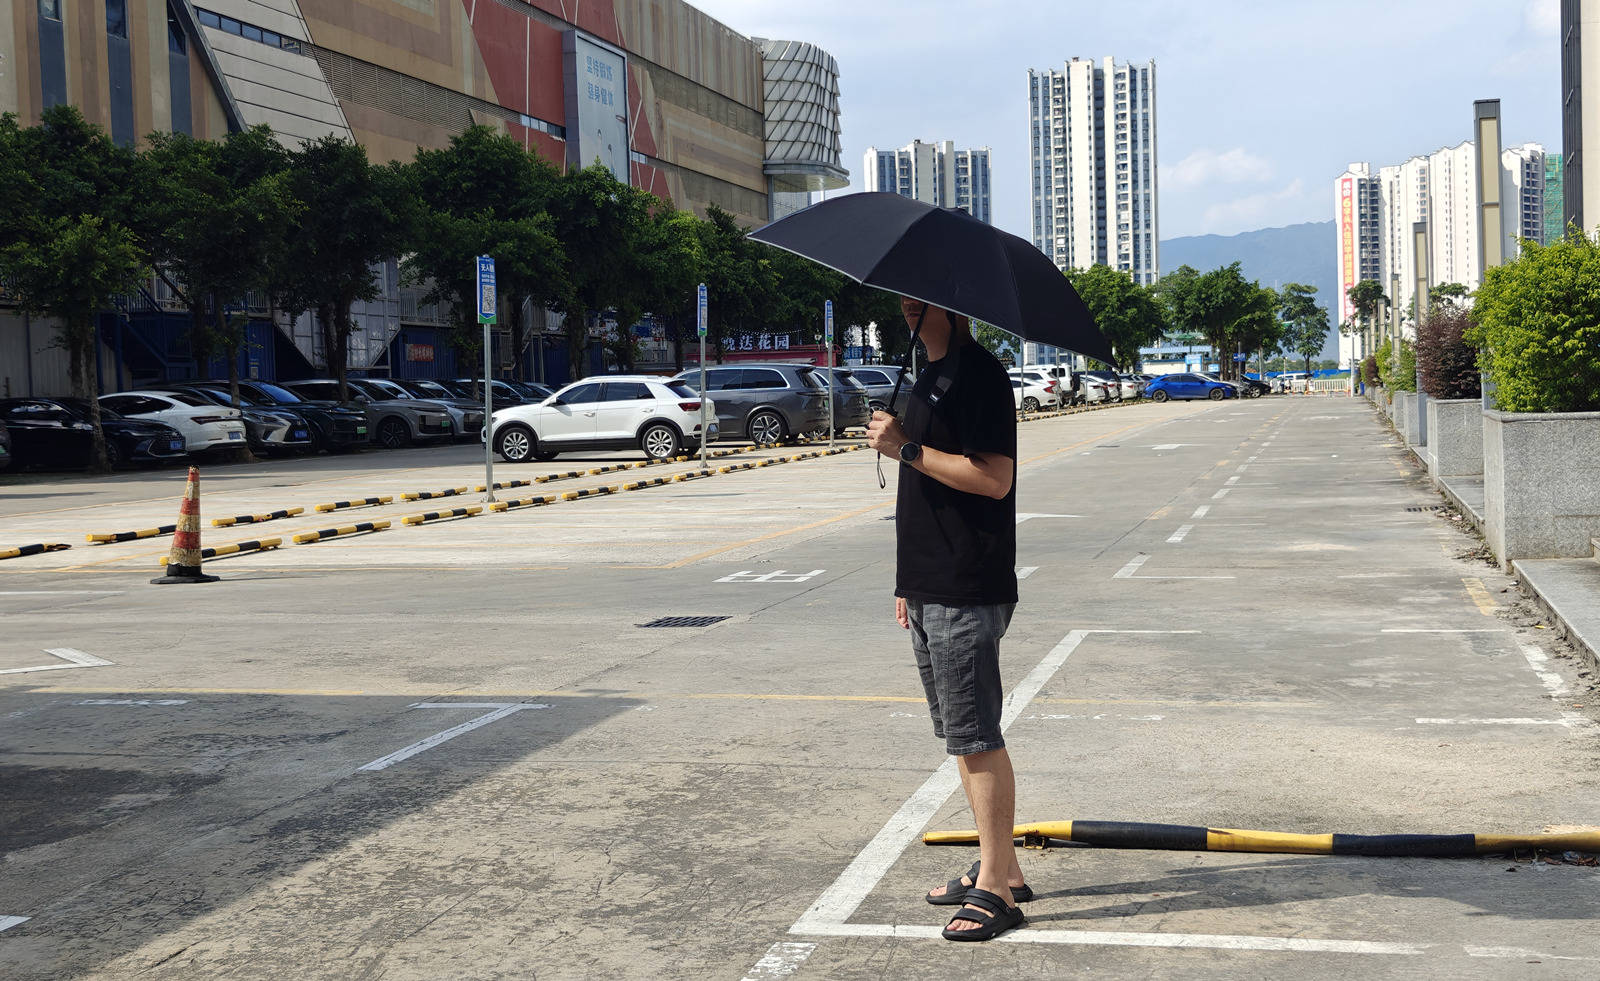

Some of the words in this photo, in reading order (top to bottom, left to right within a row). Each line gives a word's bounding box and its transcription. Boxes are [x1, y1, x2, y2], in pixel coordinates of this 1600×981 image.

[586, 55, 613, 81] 坚持锻炼
[587, 82, 614, 106] 强身健体
